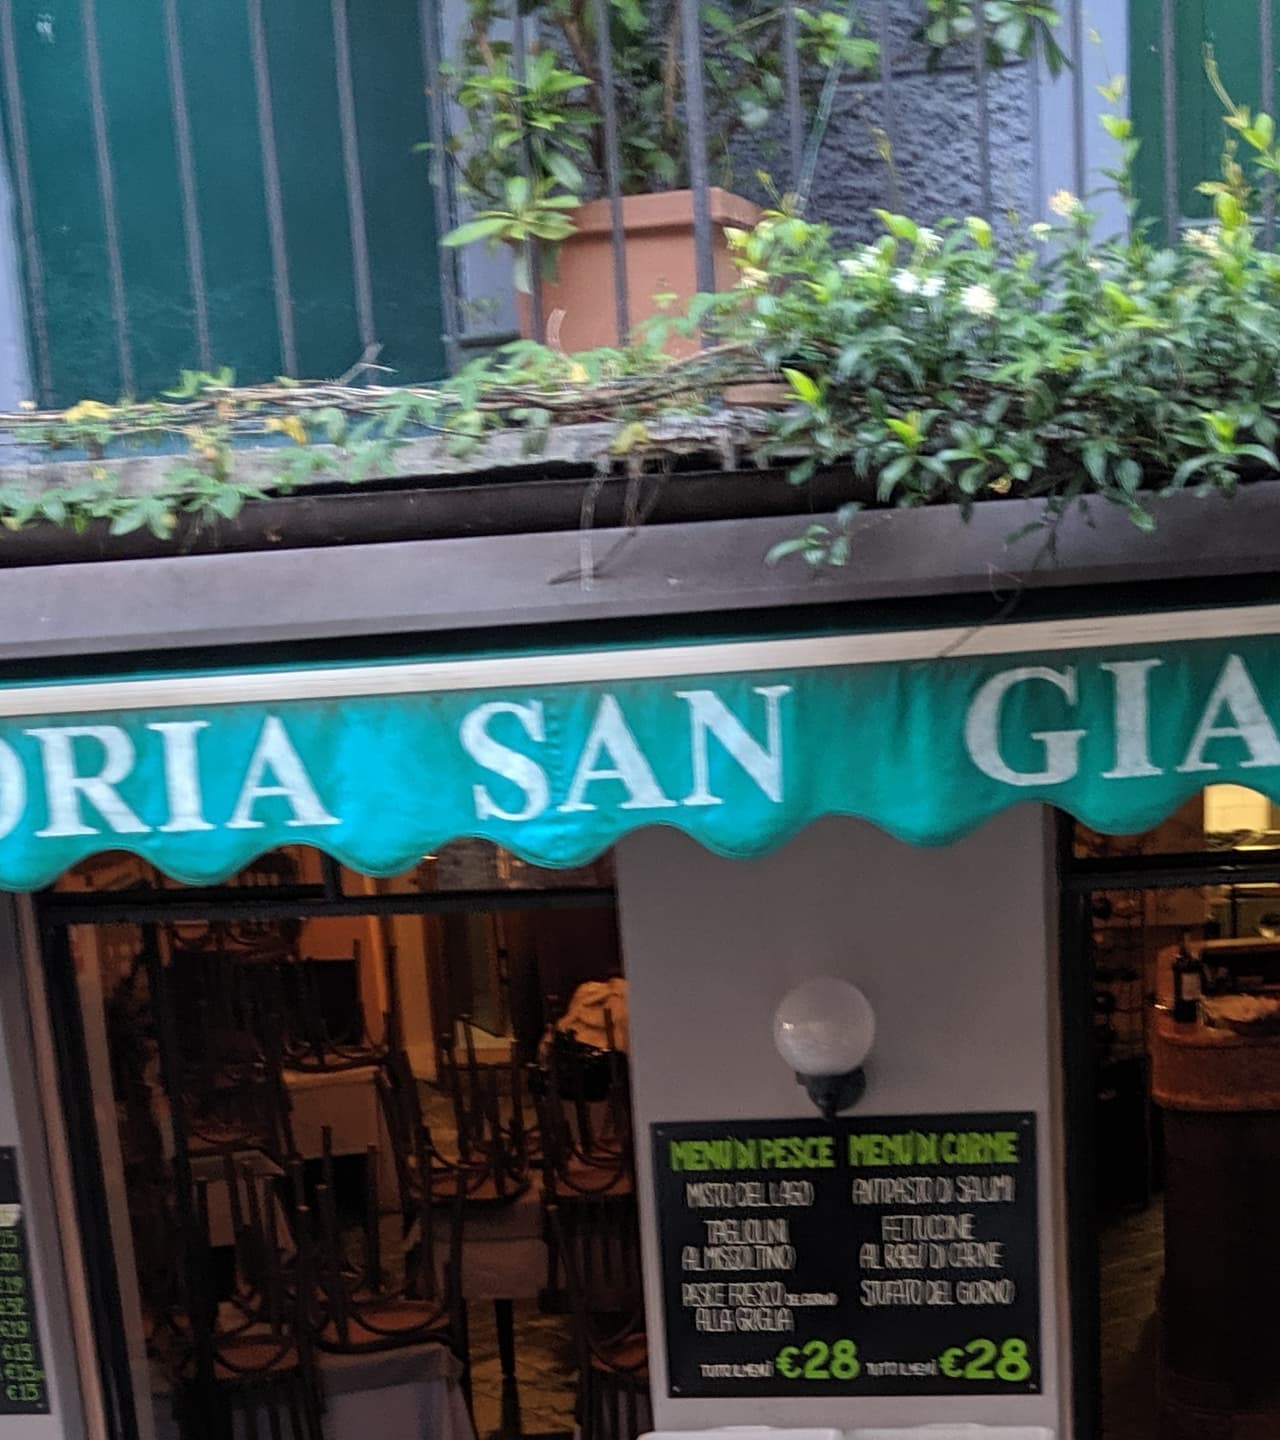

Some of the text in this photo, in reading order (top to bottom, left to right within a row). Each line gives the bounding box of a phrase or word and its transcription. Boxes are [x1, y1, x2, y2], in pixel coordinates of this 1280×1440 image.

[458, 684, 791, 822] SAN
[761, 1137, 835, 1169] PESCE
[942, 1132, 1019, 1164] CARNE
[955, 1175, 1015, 1203] SALUMI
[948, 1242, 1005, 1268] CARNE
[956, 1279, 1016, 1305] GIORNO
[775, 1339, 861, 1380] €28
[939, 1338, 1031, 1381] €28
